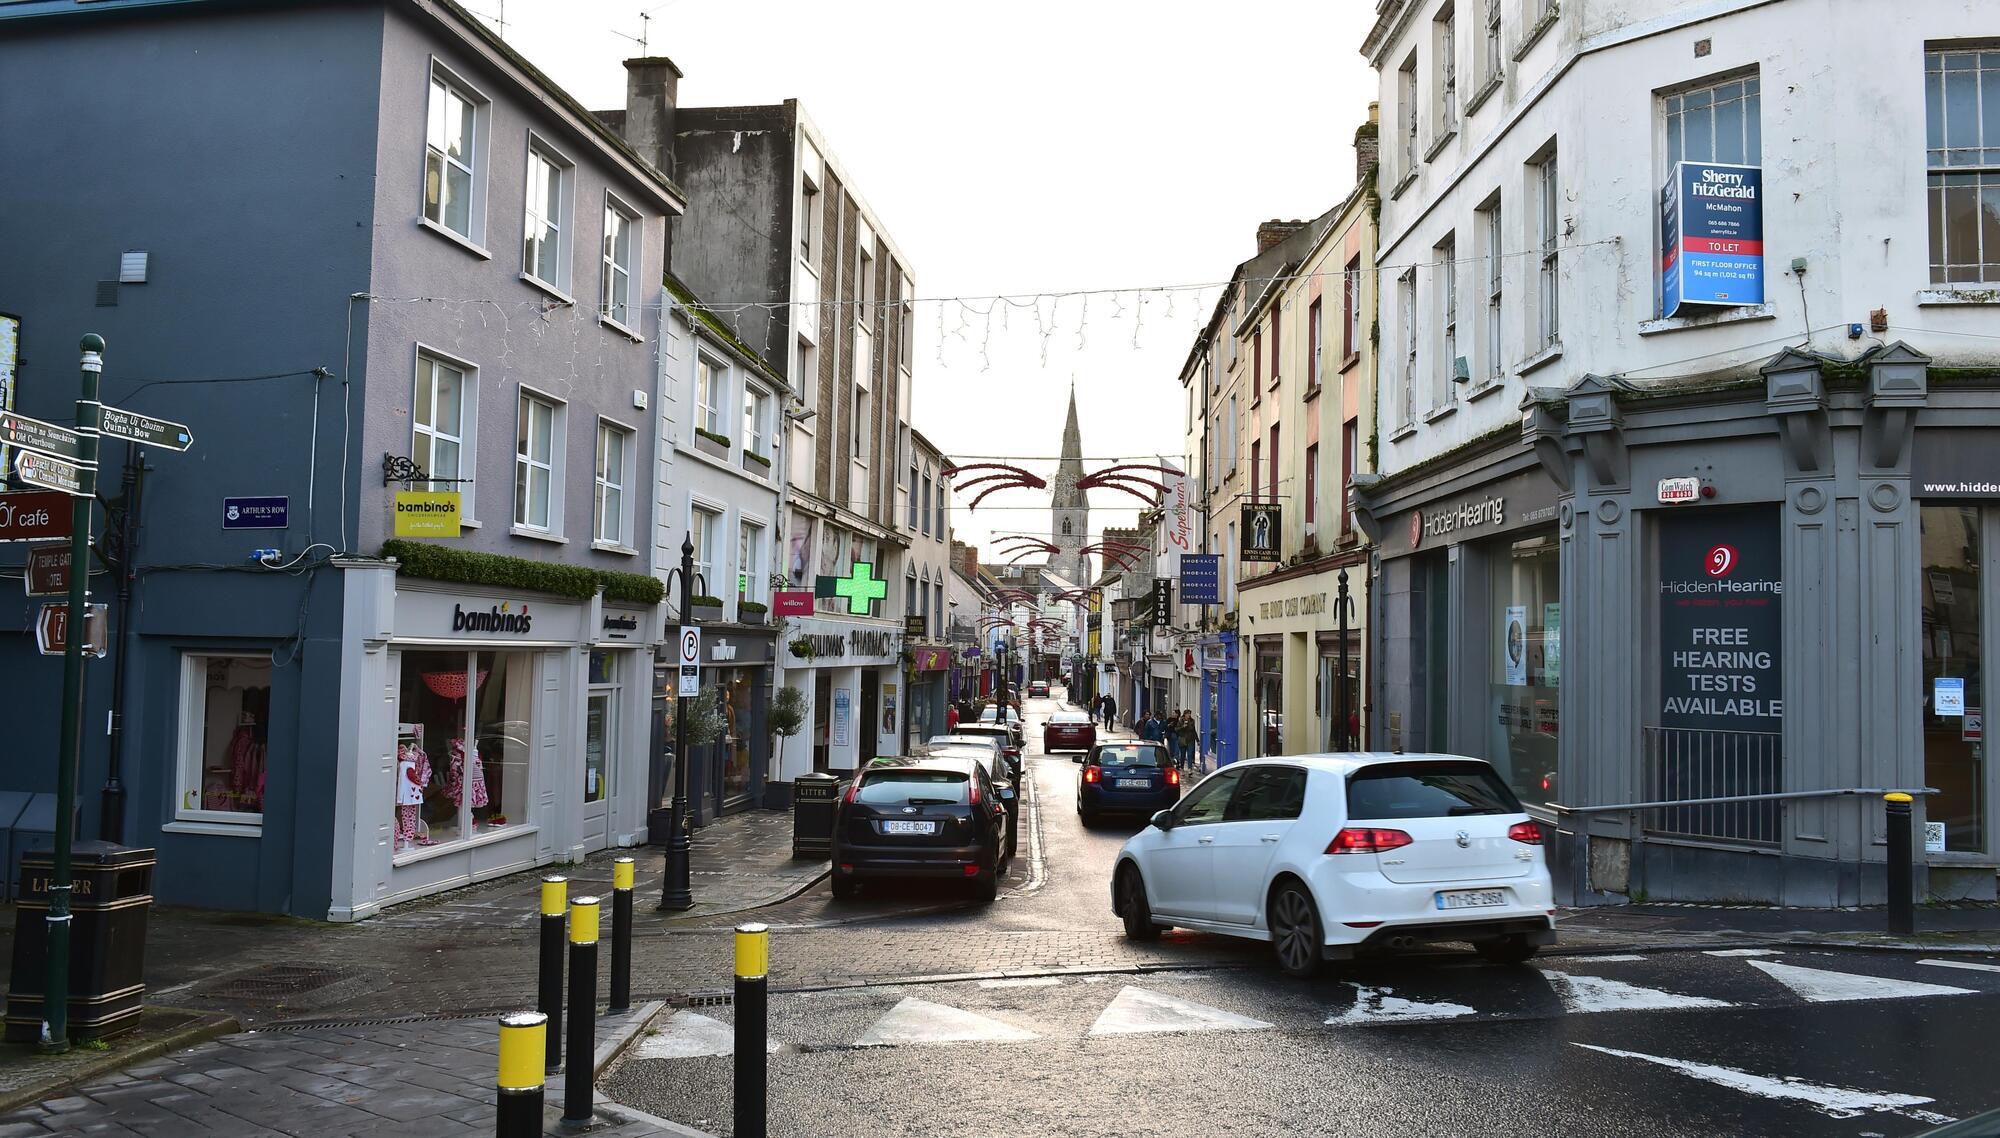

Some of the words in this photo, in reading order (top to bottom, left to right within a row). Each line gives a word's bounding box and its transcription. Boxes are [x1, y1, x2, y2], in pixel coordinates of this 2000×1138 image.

[1702, 169, 1744, 188] Sherry
[1692, 182, 1755, 199] FitzGerald
[1706, 203, 1742, 213] McMahon
[1709, 242, 1720, 251] TO
[1722, 243, 1739, 252] LET
[1691, 260, 1709, 268] FIRST
[1711, 261, 1732, 269] FLOOR
[1734, 262, 1757, 270] OFFICE
[1704, 271, 1711, 279] sq
[103, 420, 132, 435] Quinn's
[134, 427, 151, 439] Bow
[16, 431, 26, 442] Old
[27, 434, 56, 450] Courthouse
[1661, 481, 1693, 491] ComWatch
[271, 506, 286, 514] ROW
[397, 500, 456, 512] bambino's
[19, 508, 49, 527] café
[1423, 495, 1503, 538] HiddenHearing
[38, 555, 58, 568] TEMPLE
[1660, 579, 1782, 594] HiddenHearing
[1157, 580, 1166, 625] TATTOO
[452, 601, 532, 633] bambino's
[851, 629, 891, 657] PHARMACY
[1692, 628, 1749, 645] FREE
[1673, 651, 1771, 669] HEARING
[1687, 674, 1756, 692] TESTS
[1663, 696, 1783, 717] AVAILABLE
[801, 788, 827, 796] LITTER
